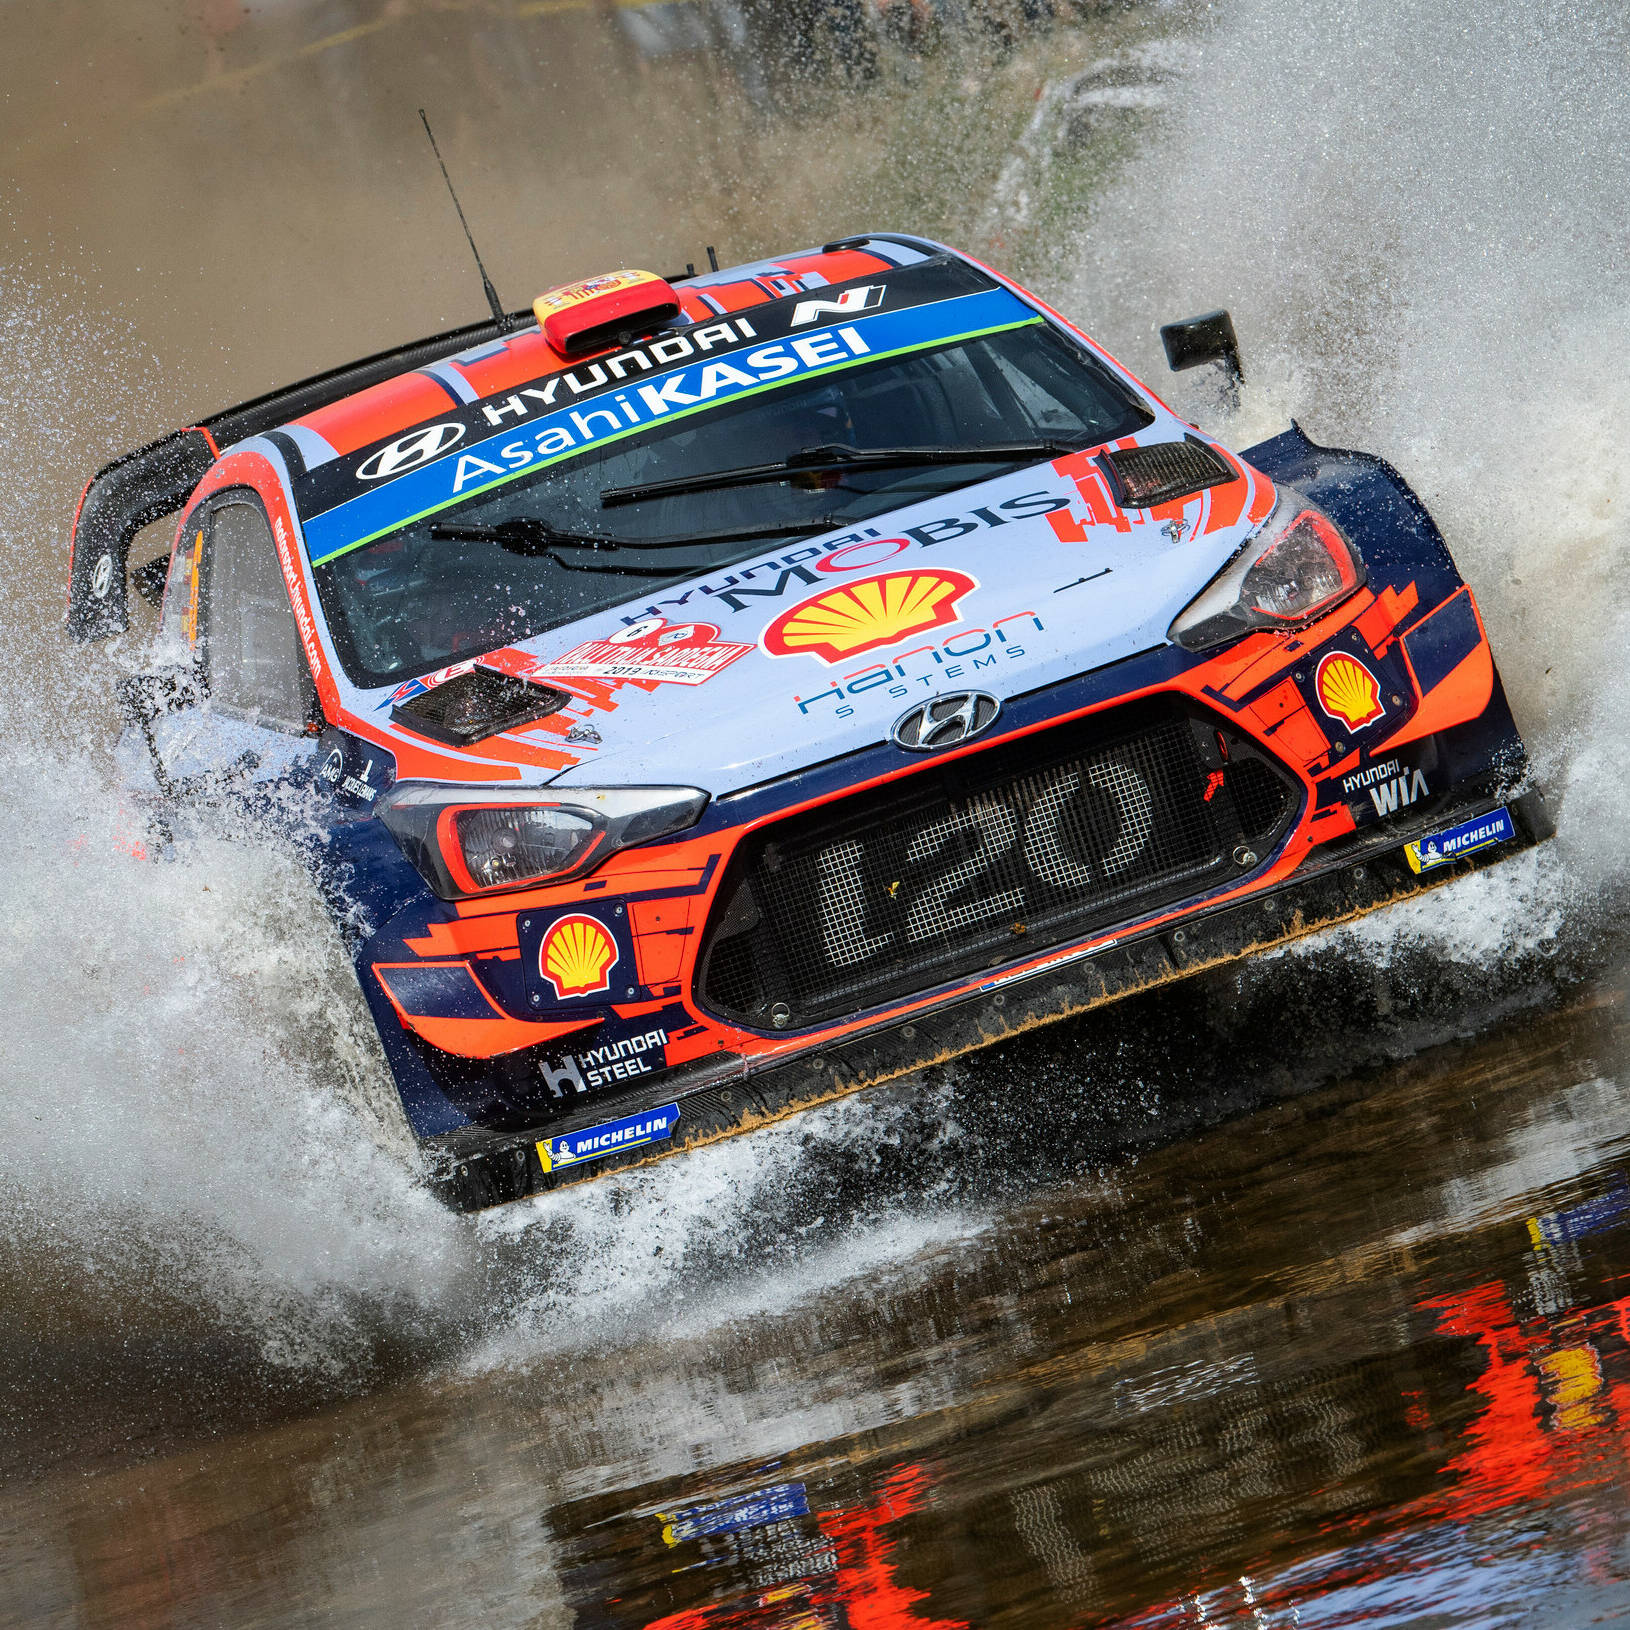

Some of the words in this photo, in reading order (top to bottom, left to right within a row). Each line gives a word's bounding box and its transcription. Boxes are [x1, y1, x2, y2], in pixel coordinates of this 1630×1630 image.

[481, 317, 757, 426] HYUNDAI
[712, 490, 1071, 613] MOBIS
[620, 528, 881, 627] HYUNDAI
[274, 516, 322, 680] motorsport.hyundai.com
[553, 642, 617, 664] RALLY
[594, 646, 660, 665] ITALIA
[637, 645, 747, 671] SARDEGNA
[602, 666, 642, 675] 2019
[1342, 758, 1400, 794] HYUNDAI
[1443, 819, 1505, 855] MICHELIN
[578, 1028, 668, 1069] HYUNDAI
[586, 1057, 652, 1087] STEEL
[576, 1116, 667, 1154] MICHELIN
